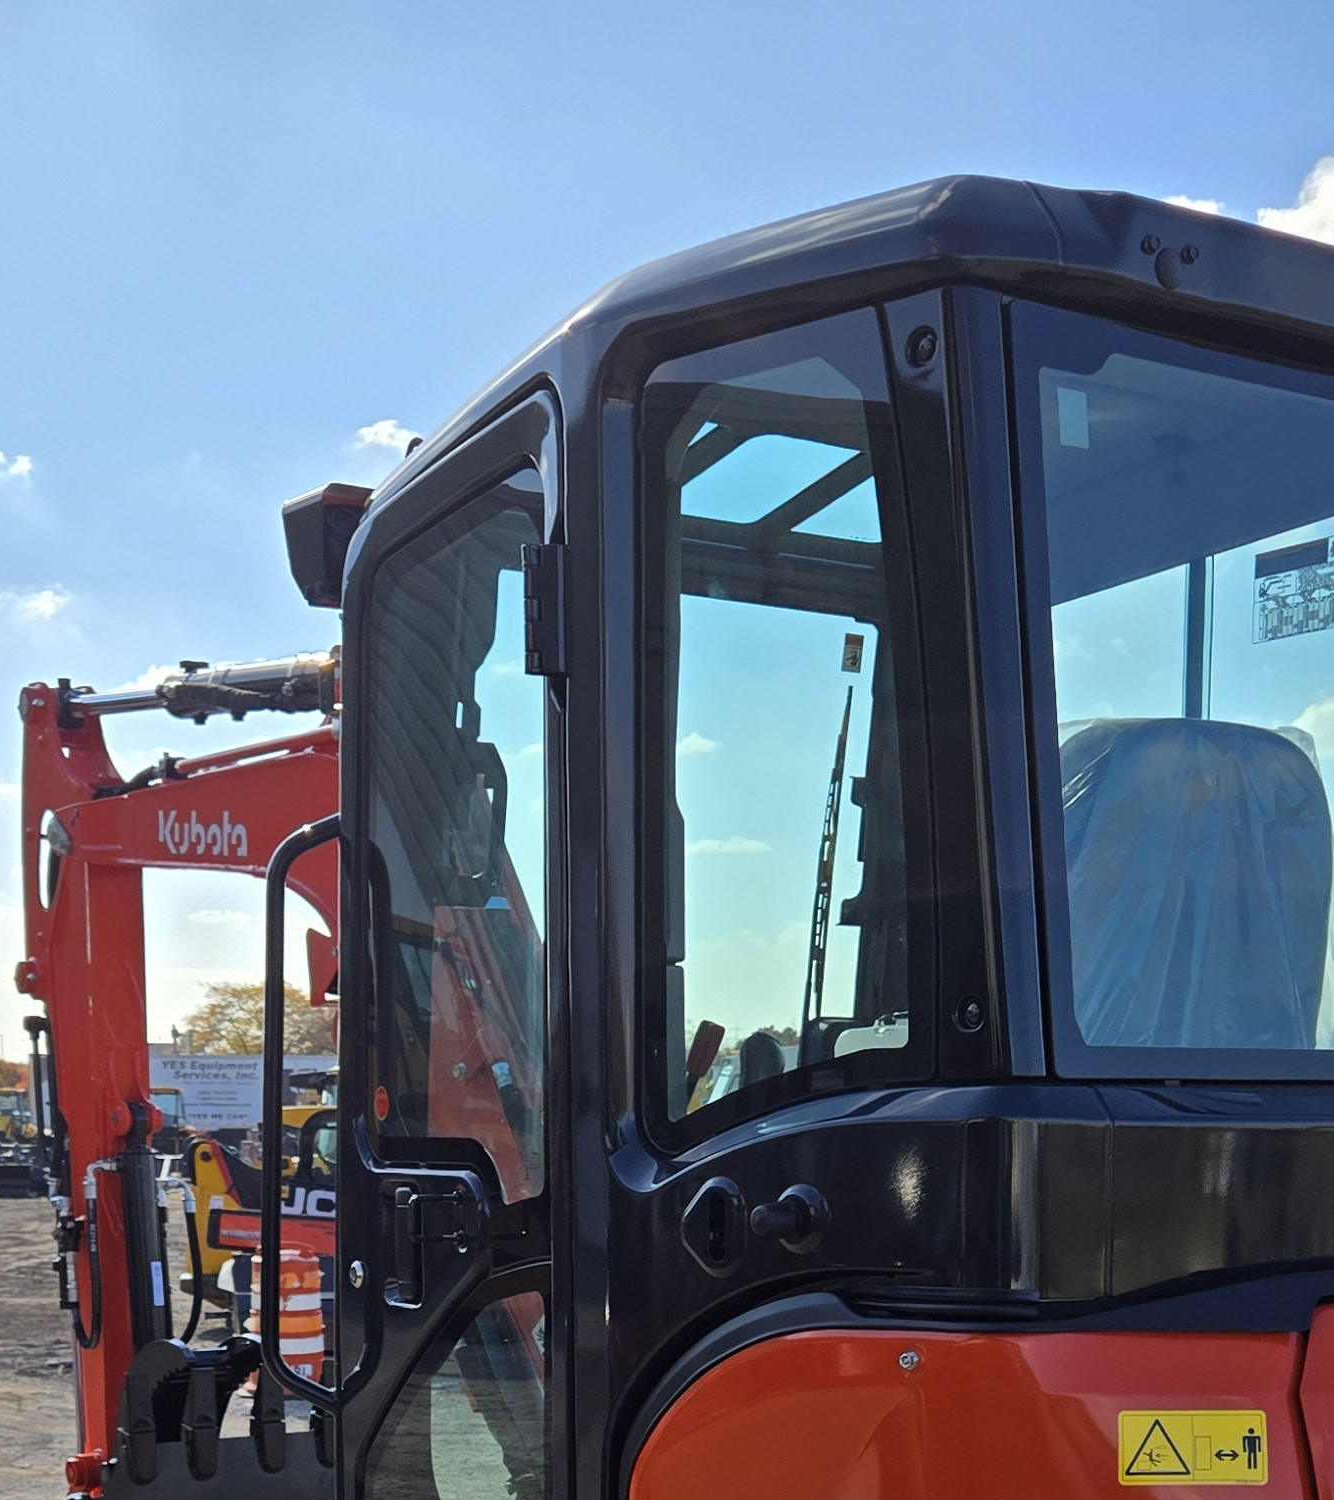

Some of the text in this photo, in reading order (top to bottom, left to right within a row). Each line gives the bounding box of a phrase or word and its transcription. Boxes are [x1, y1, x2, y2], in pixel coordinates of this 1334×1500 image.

[157, 809, 249, 857] Kubota
[161, 1060, 258, 1072] YES Equipment
[173, 1070, 260, 1081] Services, Inc.
[281, 1186, 336, 1218] JC
